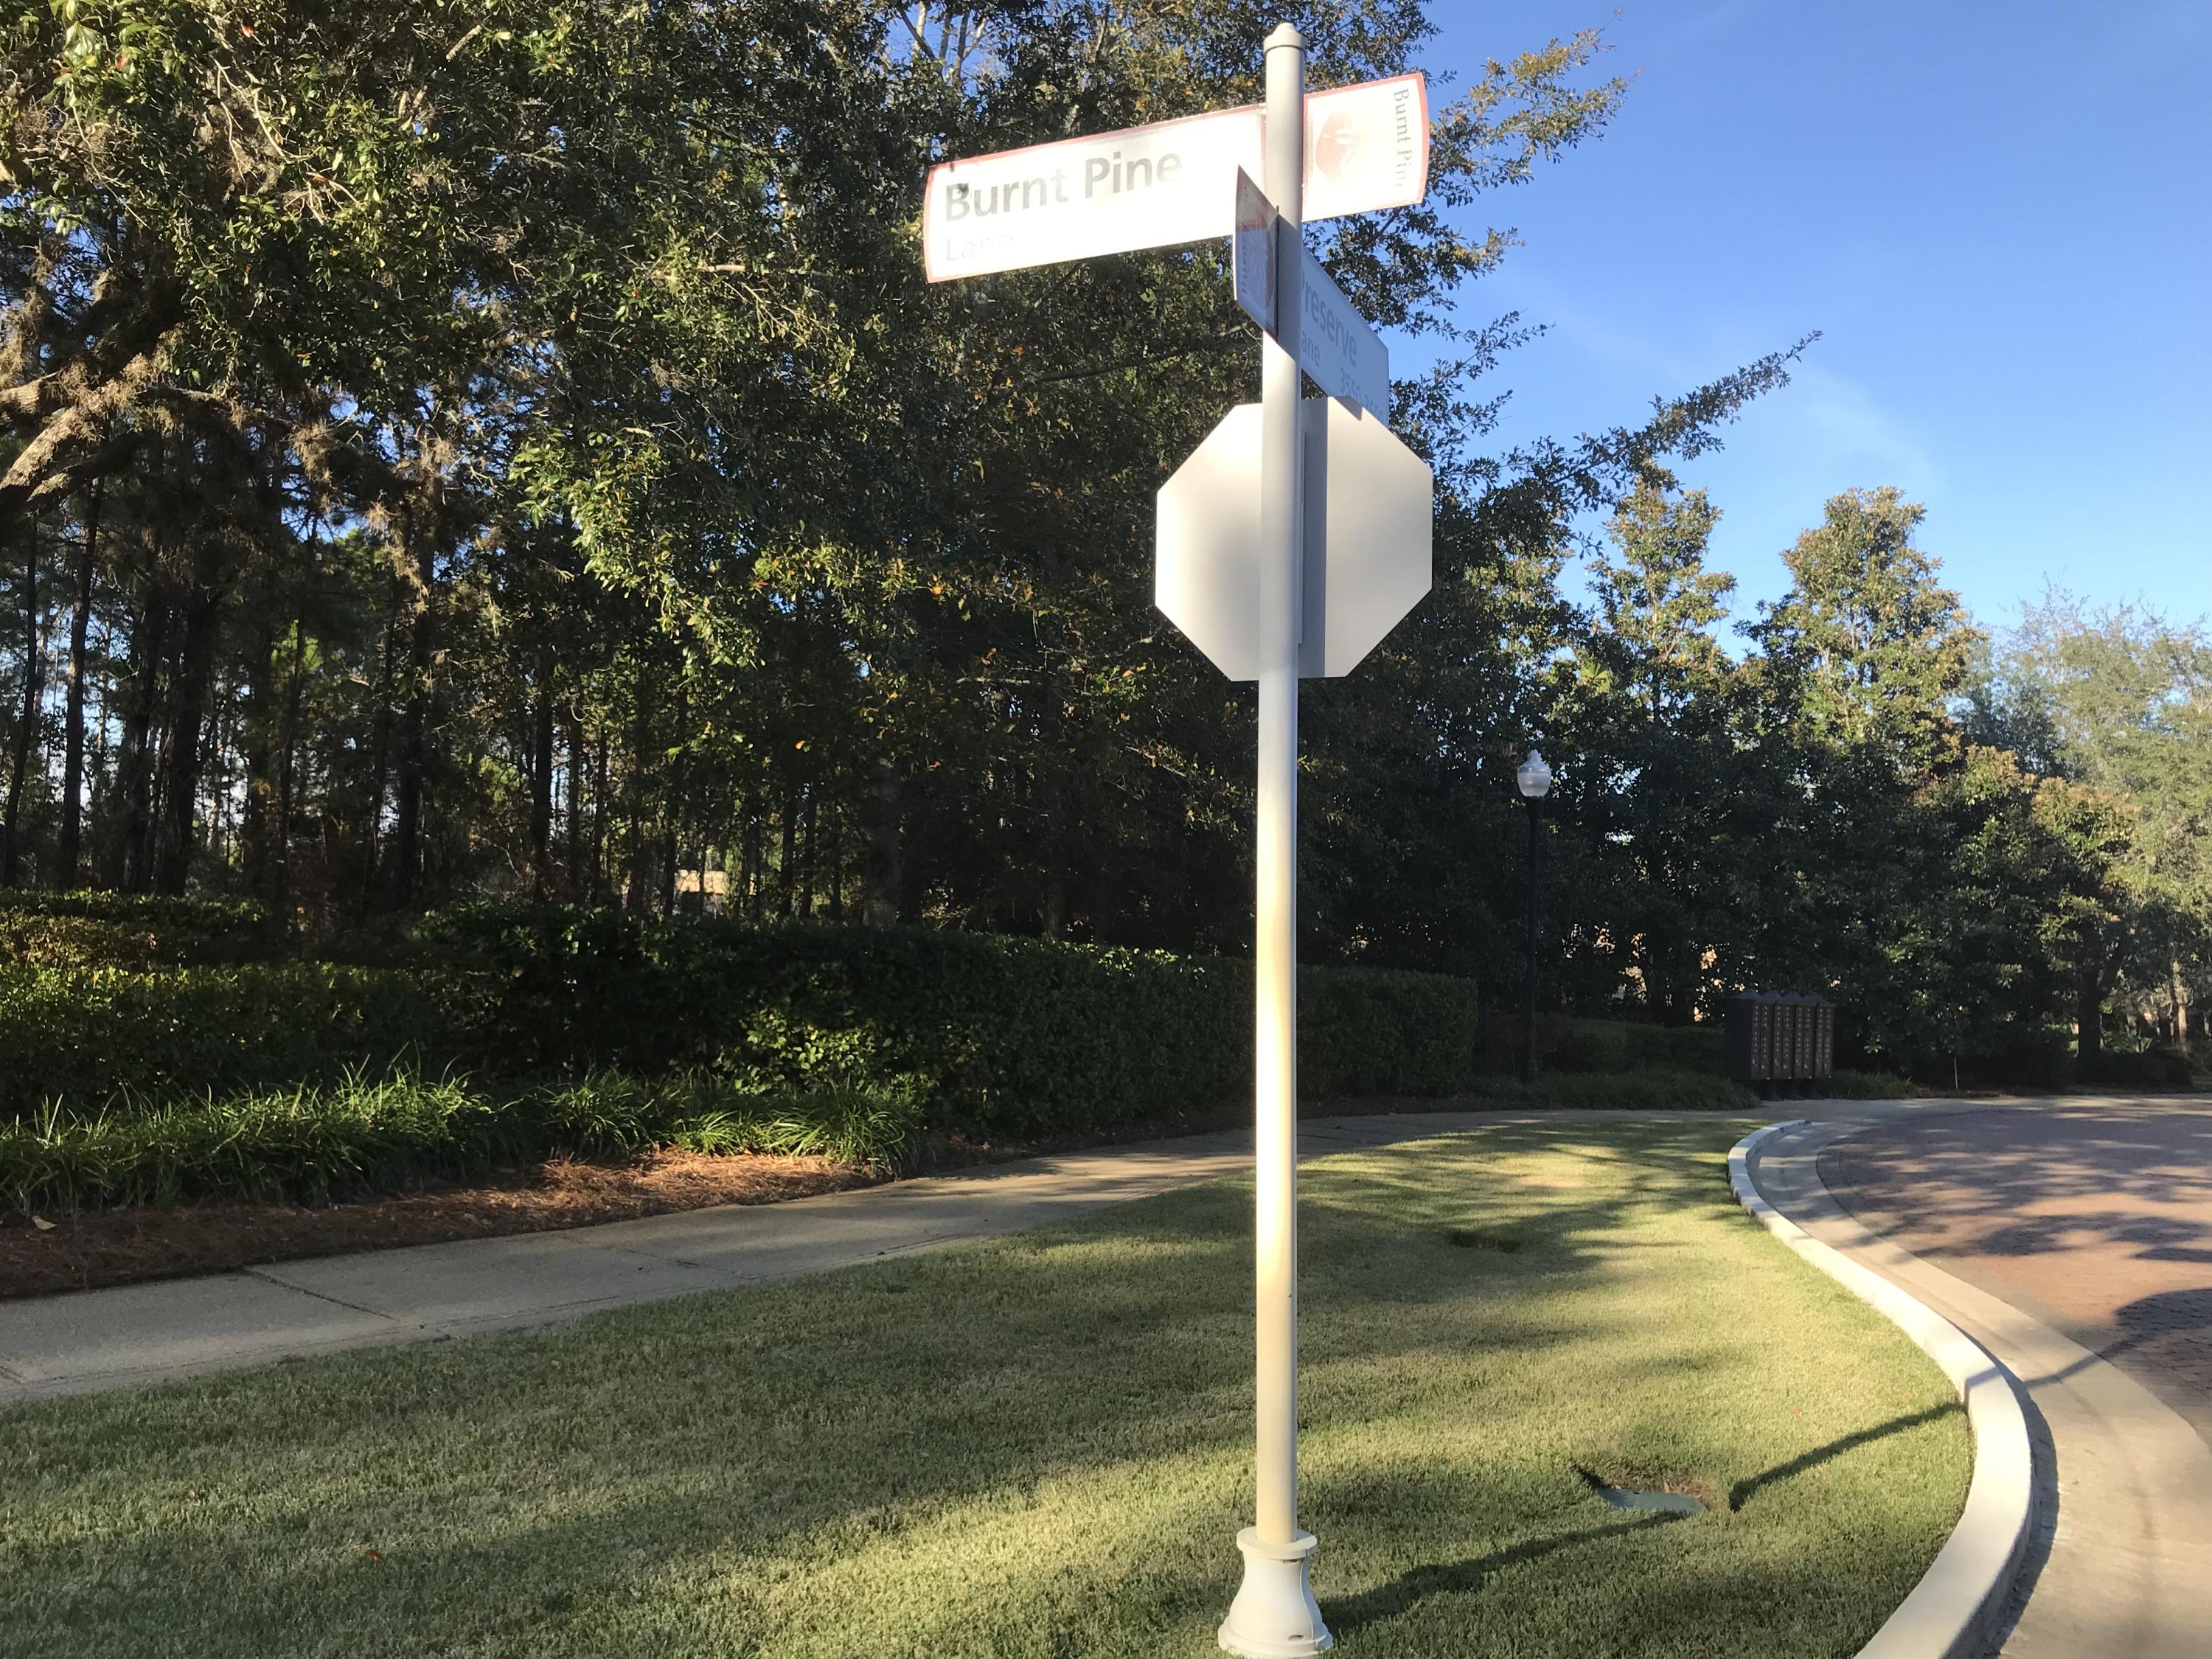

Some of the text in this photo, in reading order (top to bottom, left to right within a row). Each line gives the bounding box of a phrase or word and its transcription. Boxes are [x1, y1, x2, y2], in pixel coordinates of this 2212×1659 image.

[1393, 88, 1411, 144] Burnt
[945, 150, 1183, 222] Burnt Pine
[1301, 330, 1320, 367] ane
[1302, 271, 1357, 366] reserve
